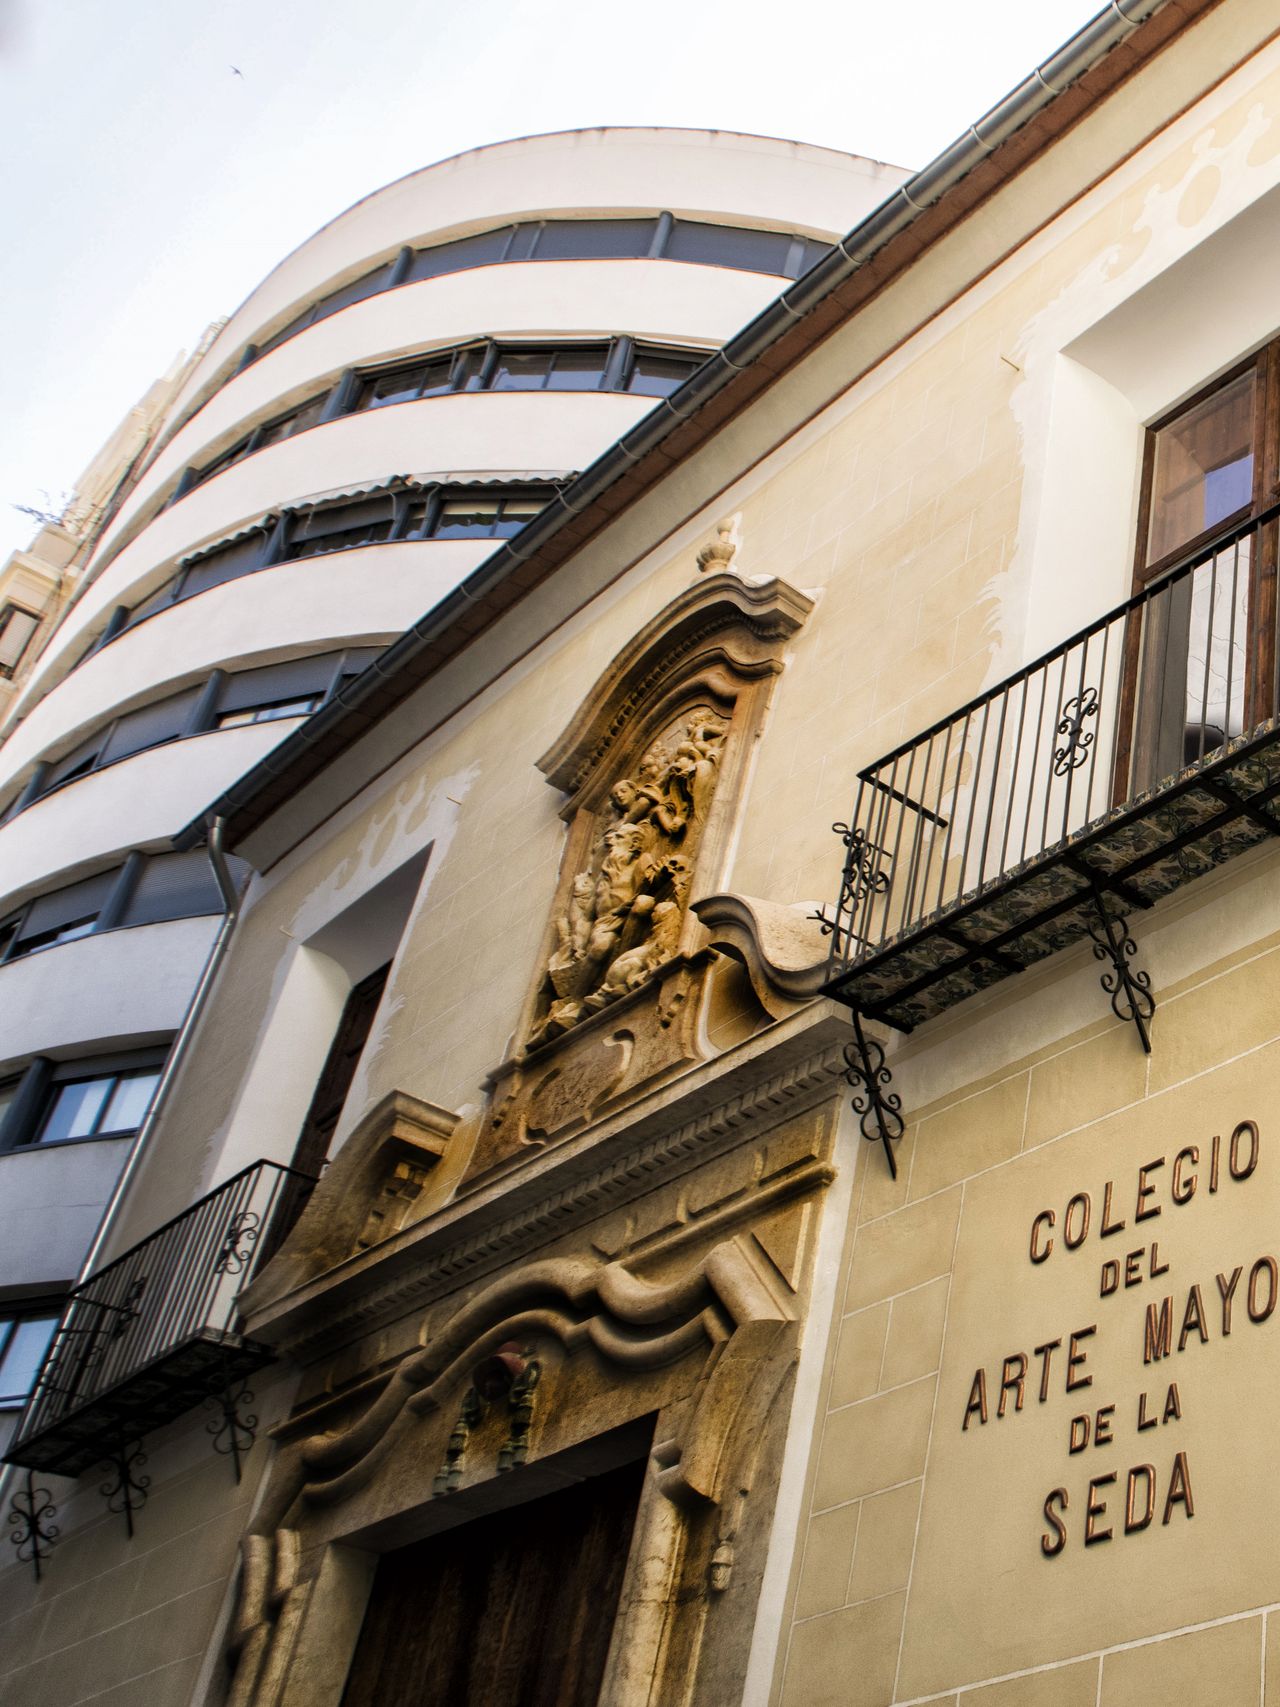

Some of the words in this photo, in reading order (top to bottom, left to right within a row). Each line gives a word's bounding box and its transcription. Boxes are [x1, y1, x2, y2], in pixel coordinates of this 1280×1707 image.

[1029, 1119, 1260, 1265] COLEGIO
[1100, 1242, 1170, 1297] DEL
[962, 1324, 1097, 1431] ARTE
[1069, 1404, 1116, 1454] DE
[1138, 1382, 1182, 1431] LA
[1041, 1451, 1195, 1558] SEDA
